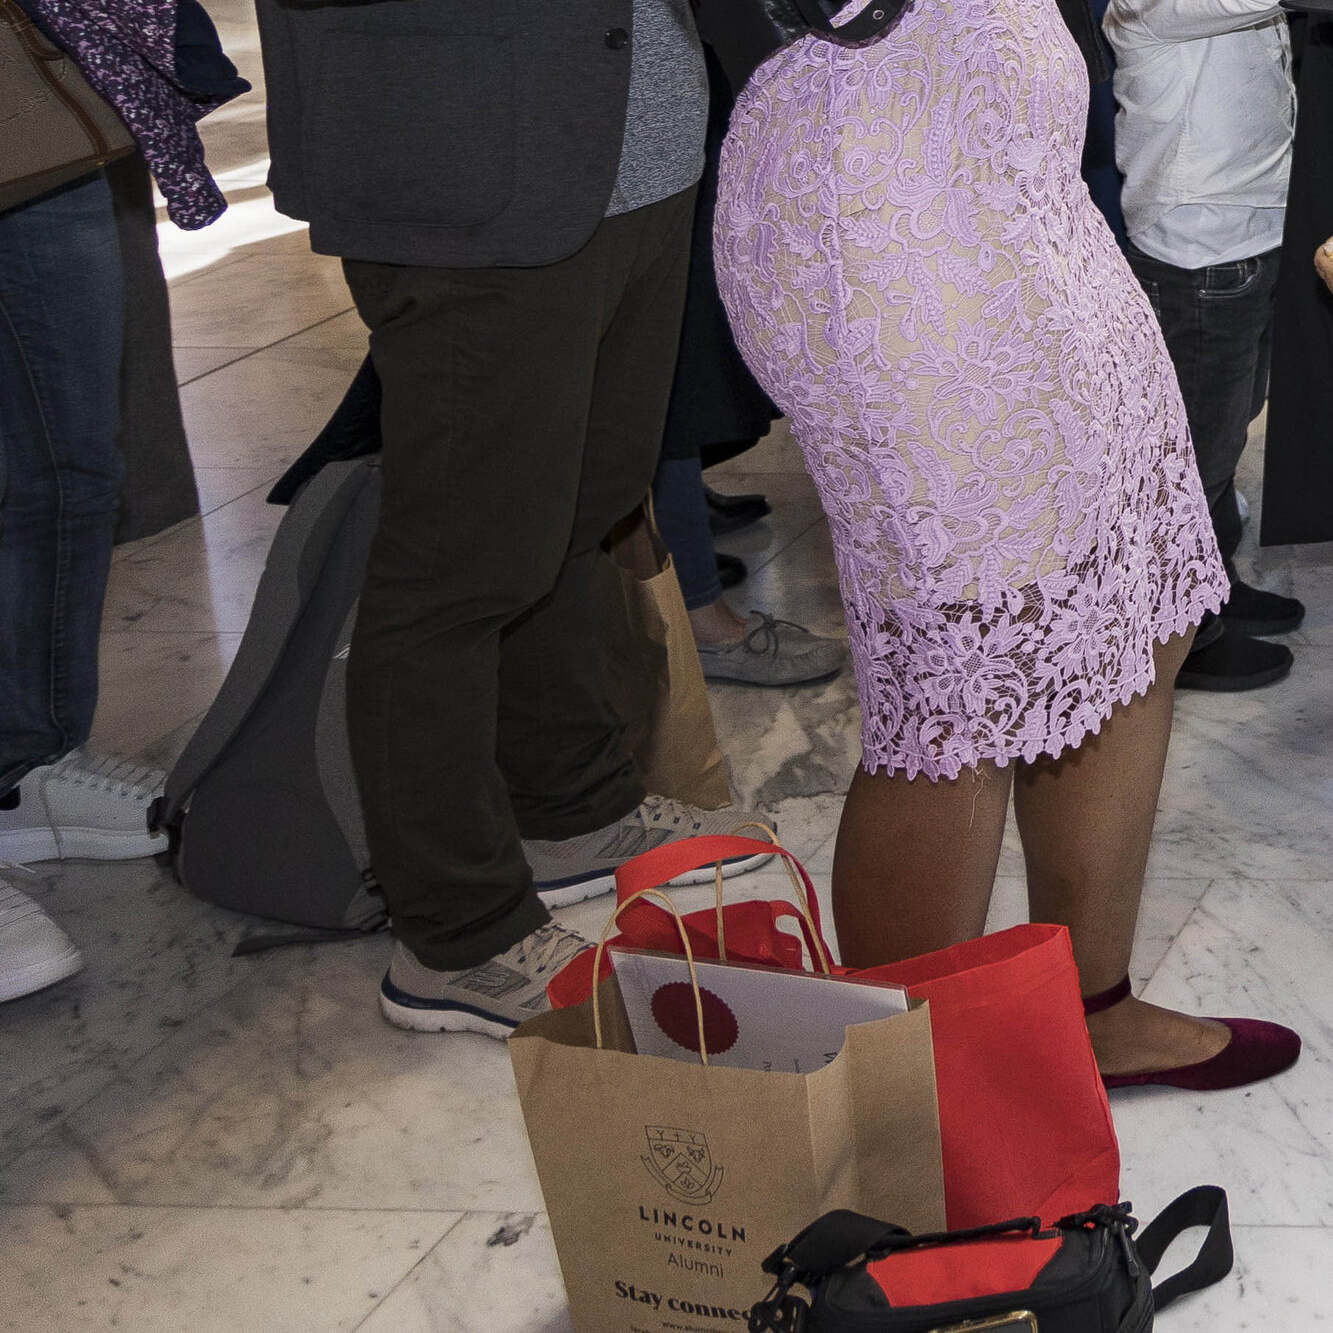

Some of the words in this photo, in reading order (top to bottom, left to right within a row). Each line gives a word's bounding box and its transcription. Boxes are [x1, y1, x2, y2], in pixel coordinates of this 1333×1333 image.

[639, 1206, 746, 1243] LINCOLN
[655, 1233, 732, 1257] UNIVERSITY
[668, 1252, 724, 1278] Alumni
[615, 1280, 662, 1310] Stay
